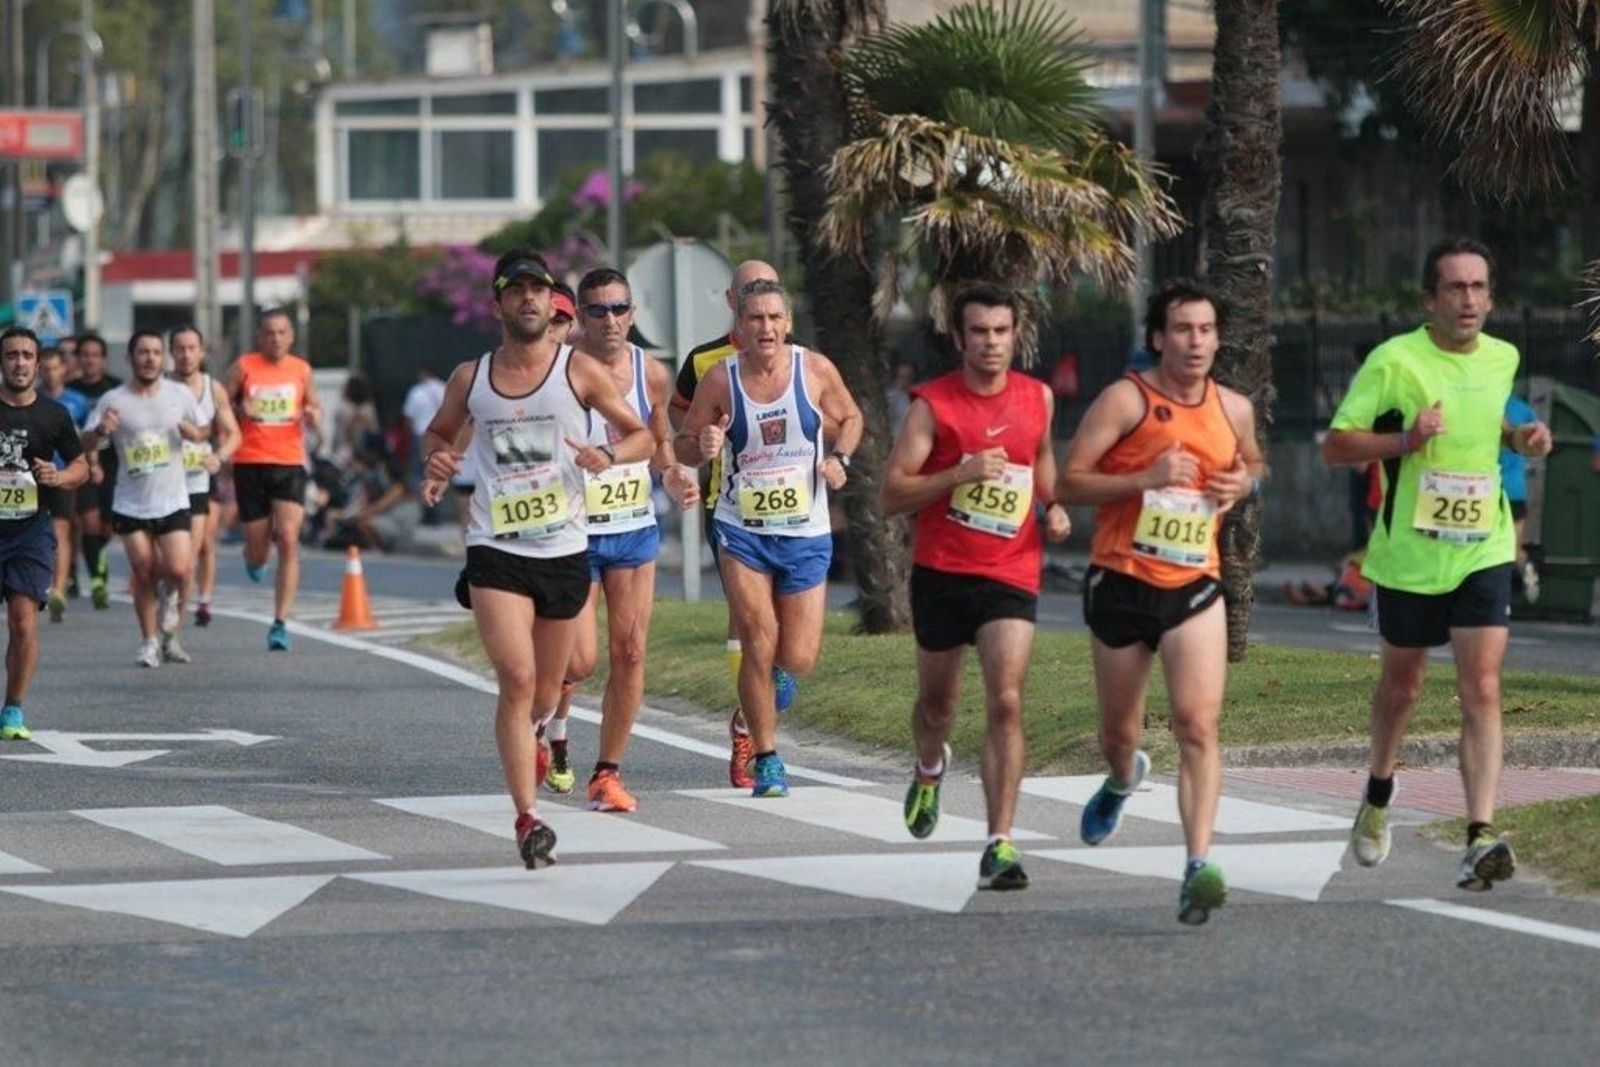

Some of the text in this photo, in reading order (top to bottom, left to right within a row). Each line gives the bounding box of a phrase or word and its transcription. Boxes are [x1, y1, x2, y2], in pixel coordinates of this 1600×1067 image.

[600, 479, 640, 505] 247
[753, 488, 798, 511] 268
[967, 484, 1018, 513] 458
[501, 492, 559, 525] 1033
[1432, 497, 1482, 523] 265
[1148, 516, 1207, 545] 1016
